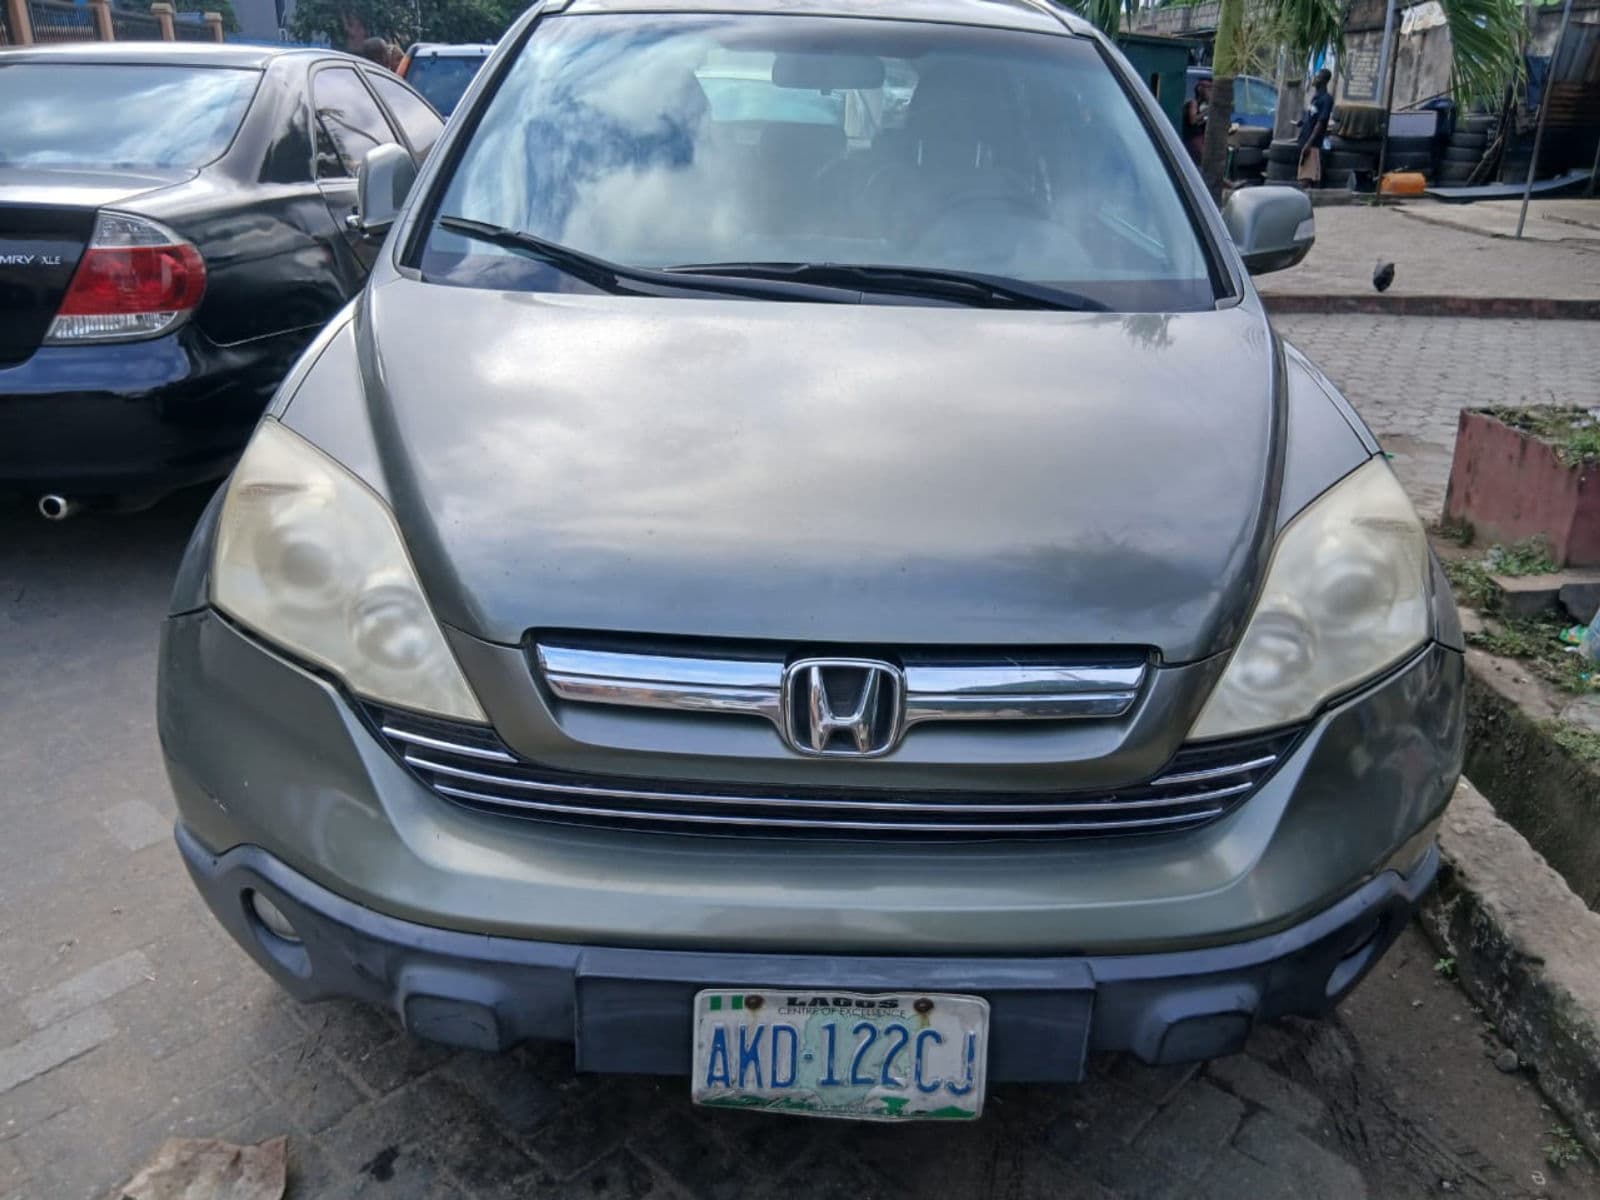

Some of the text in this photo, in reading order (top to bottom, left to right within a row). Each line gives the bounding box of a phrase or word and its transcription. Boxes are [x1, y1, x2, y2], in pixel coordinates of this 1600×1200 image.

[40, 255, 61, 265] XLE
[786, 996, 899, 1009] LAGOS
[778, 1007, 905, 1018] CENTRE OF EXCELLENCE
